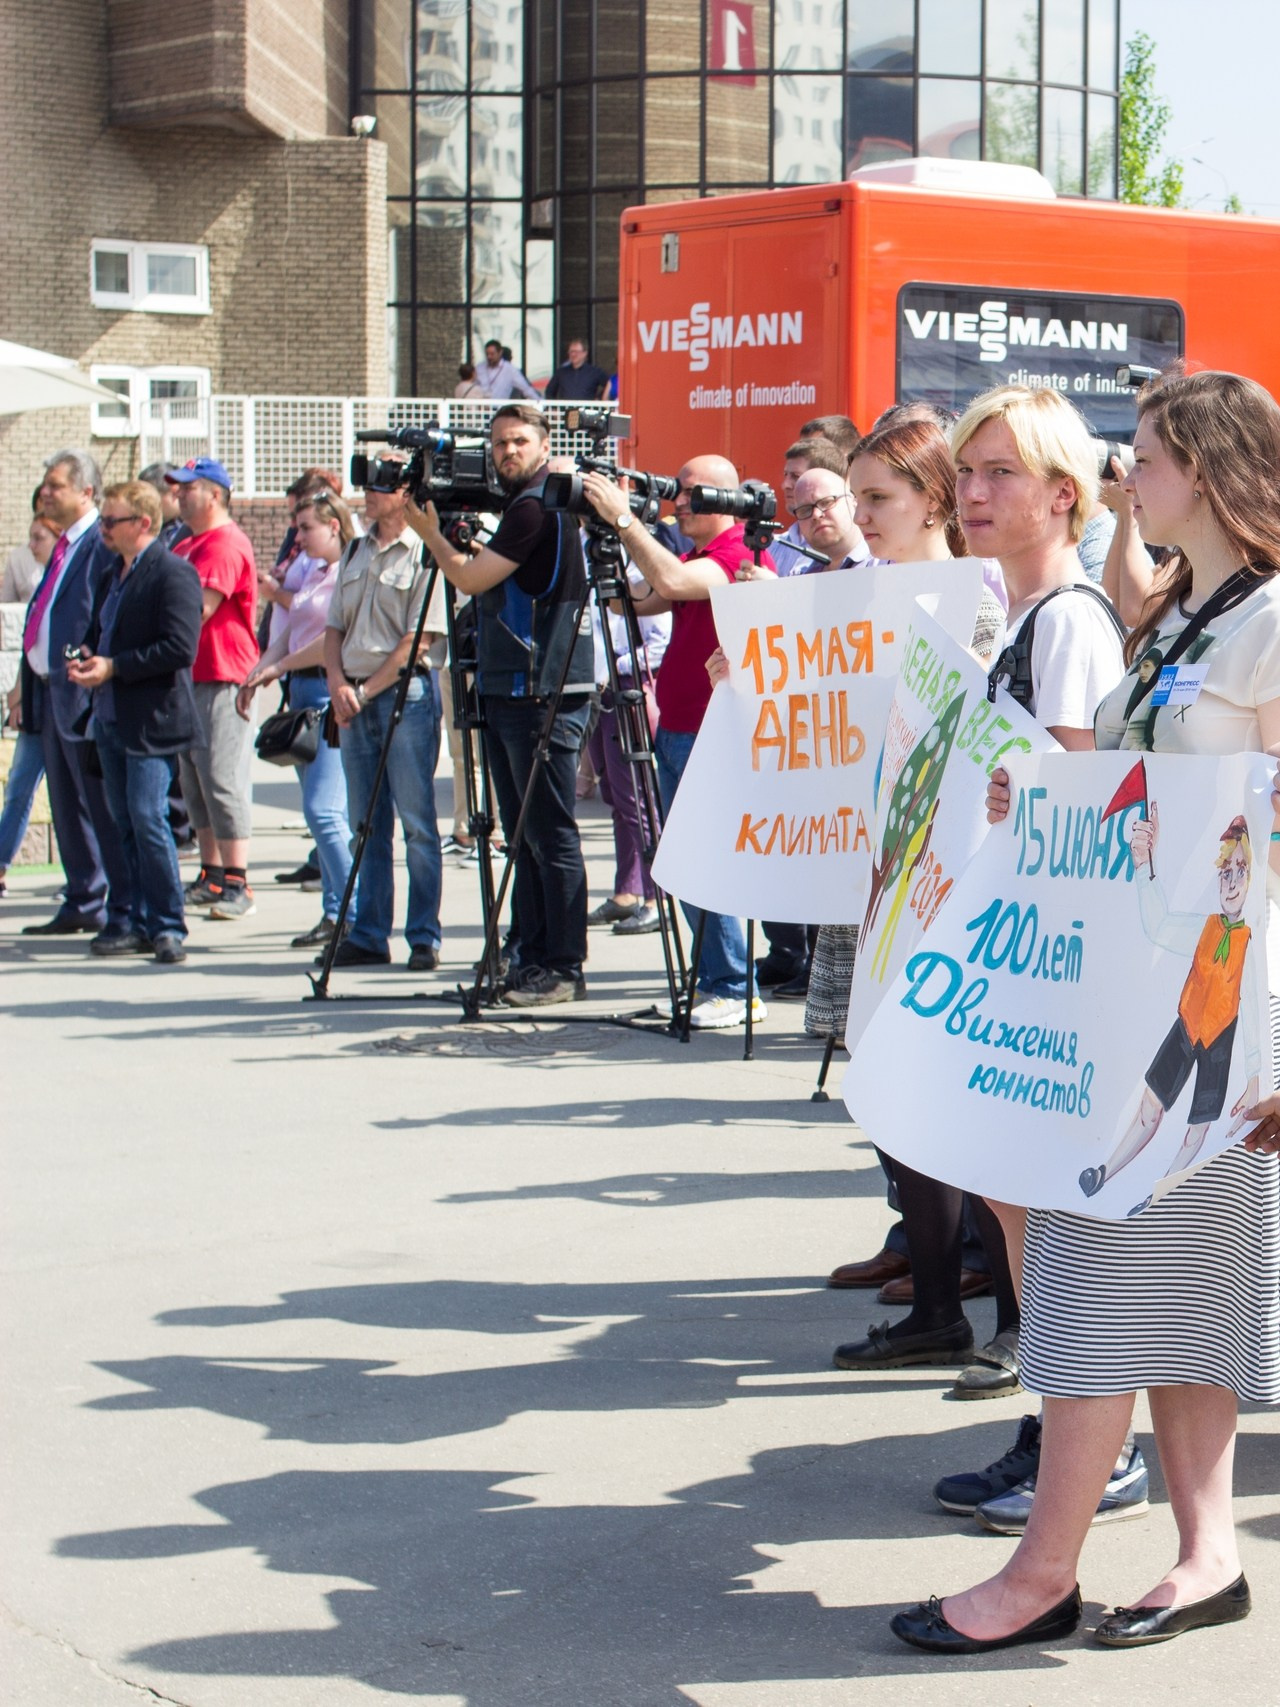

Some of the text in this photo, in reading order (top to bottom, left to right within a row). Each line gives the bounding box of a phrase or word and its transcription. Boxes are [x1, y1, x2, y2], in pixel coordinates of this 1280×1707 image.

[639, 303, 803, 371] VIESSMANN
[904, 302, 1127, 362] VIESSMANN
[690, 382, 816, 409] climate of innovation
[1008, 370, 1067, 391] climate
[1074, 372, 1091, 392] of
[742, 625, 788, 695] 15
[753, 690, 865, 772] ДЕНЬ
[736, 806, 871, 856] КЛИМАТА
[1013, 788, 1046, 876] 15
[966, 898, 1083, 983] 100 лет
[900, 951, 1078, 1065] Движения
[968, 1063, 1095, 1118] юннатов
